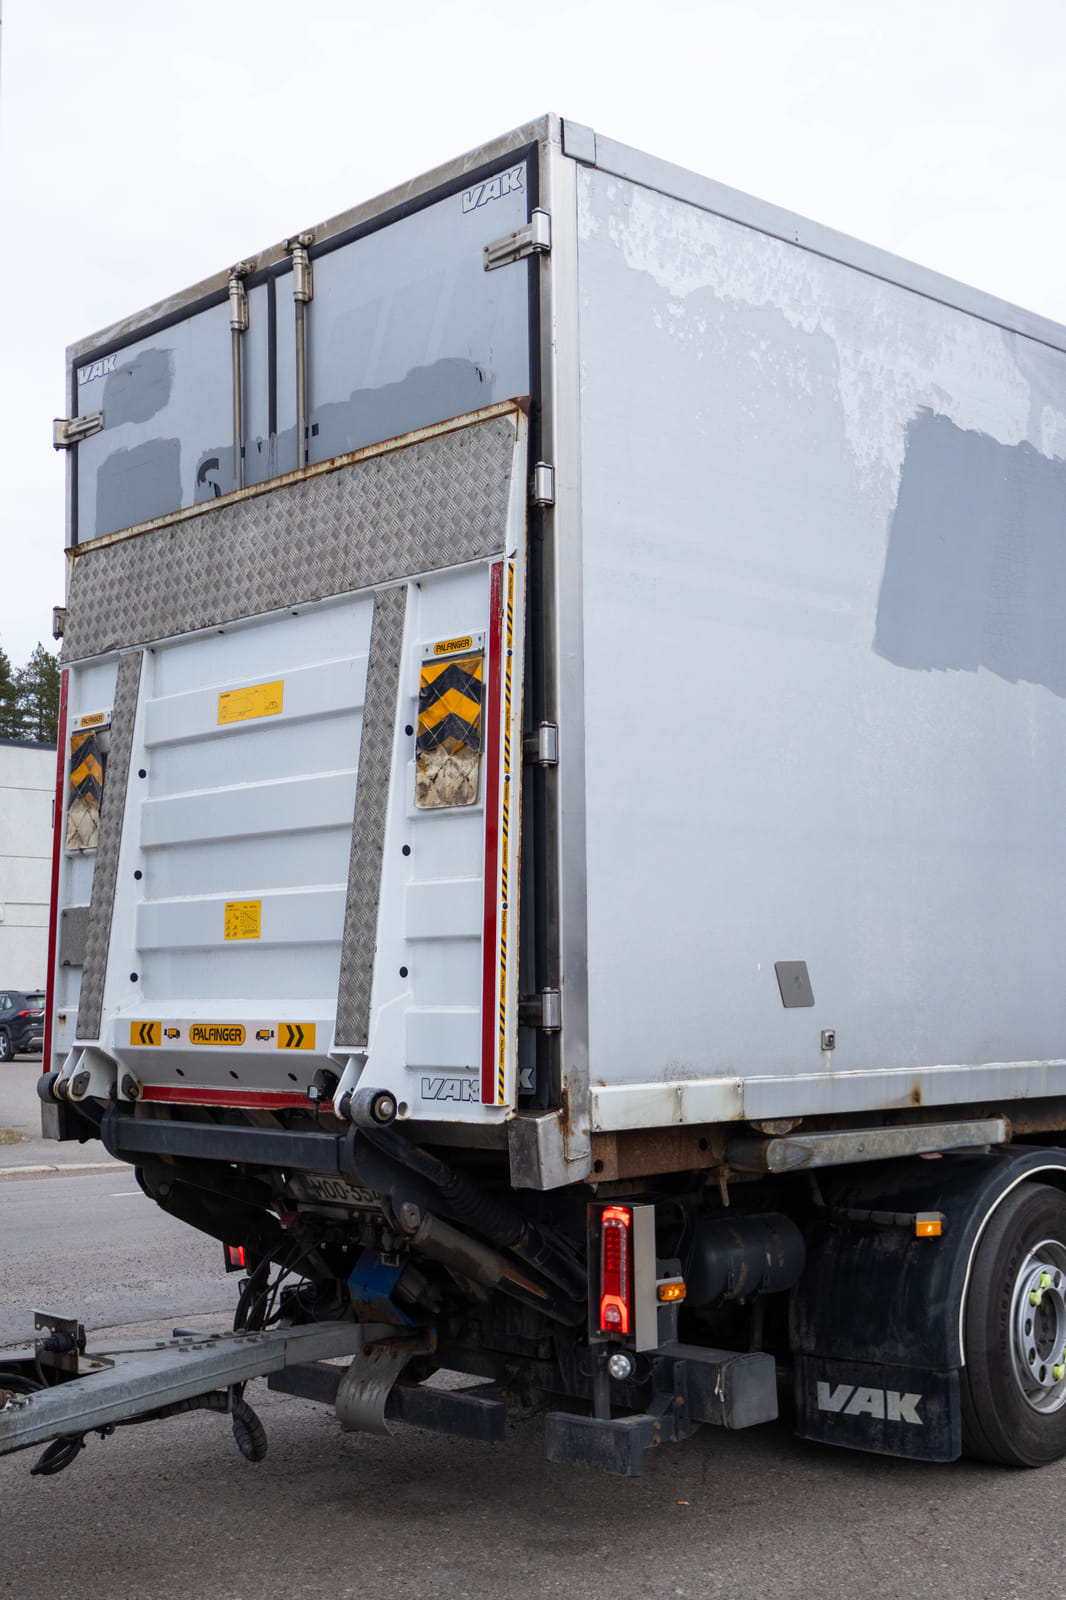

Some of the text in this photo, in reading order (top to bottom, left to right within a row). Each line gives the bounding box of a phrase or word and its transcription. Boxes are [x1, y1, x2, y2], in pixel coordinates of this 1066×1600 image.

[462, 166, 523, 215] VAK
[79, 353, 117, 386] VAK
[436, 639, 470, 653] PALFINGER
[193, 1027, 242, 1041] PALFINGER
[816, 1381, 923, 1425] VAK
